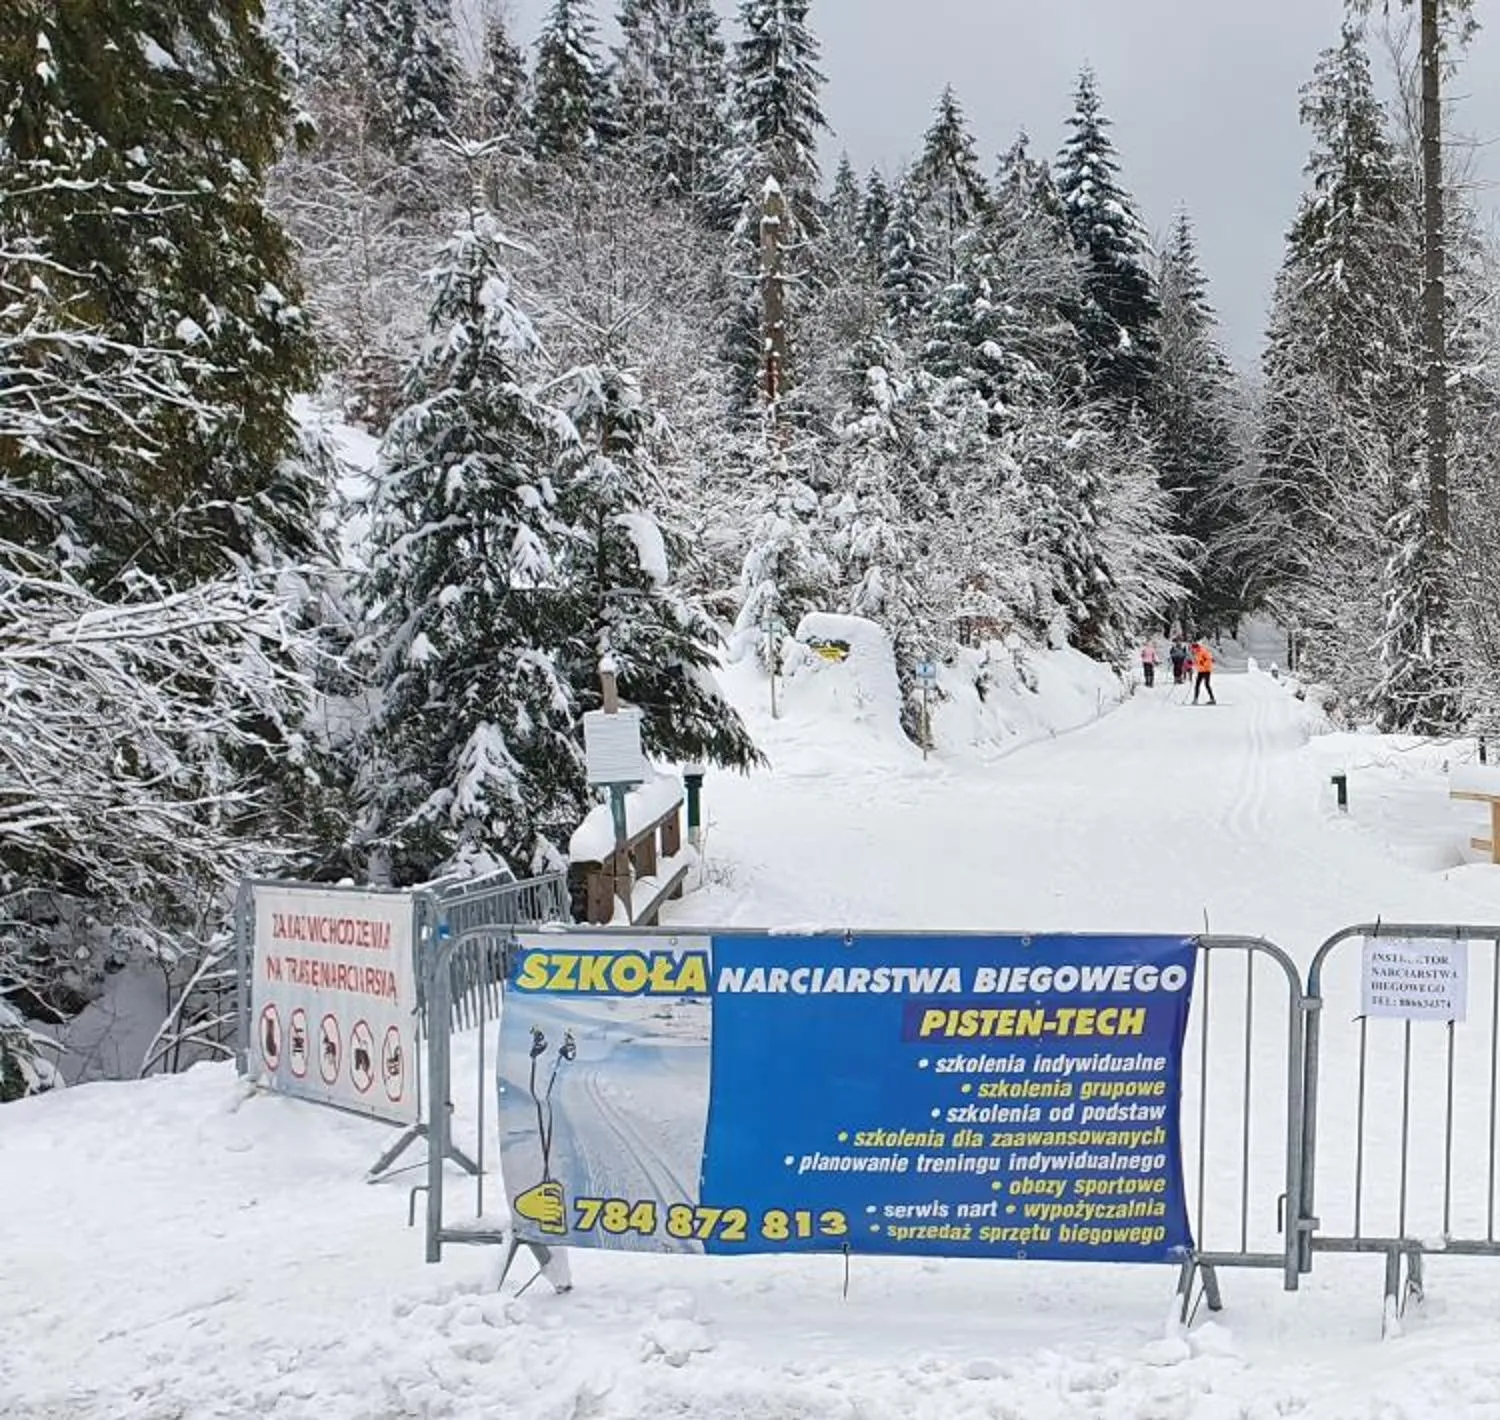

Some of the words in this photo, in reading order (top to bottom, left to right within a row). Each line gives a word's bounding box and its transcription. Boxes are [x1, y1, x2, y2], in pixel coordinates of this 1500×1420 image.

[1371, 953, 1449, 965] INSTTOR
[515, 953, 708, 992] SZKOŁA
[717, 965, 962, 994] NARCIARSTWA
[973, 964, 1188, 993] BIEGOWEGO
[1371, 967, 1458, 979] NARCIARSTWA
[1371, 981, 1445, 993] BIEGOWEGO
[919, 1007, 1147, 1037] PISTEN-TECH
[934, 1053, 1025, 1074] szkolenia
[1033, 1053, 1167, 1077] indywidualne
[977, 1079, 1073, 1098] szkolenia
[1079, 1080, 1166, 1101] grupowe
[946, 1103, 1041, 1123] szkolenia
[1049, 1103, 1072, 1122] od
[1081, 1103, 1166, 1124] podstaw
[853, 1127, 945, 1148] szkolenia
[952, 1128, 984, 1148] dla
[991, 1127, 1166, 1148] zaawansowanych
[798, 1152, 908, 1174] planowanie
[916, 1153, 1000, 1173] treningu
[1008, 1151, 1166, 1172] indywidualnego
[1009, 1176, 1066, 1198] obozy
[1074, 1177, 1166, 1197] sportowe
[574, 1198, 657, 1235] 784
[667, 1202, 748, 1240] 872
[762, 1208, 849, 1241] 813
[883, 1203, 949, 1219] serwis
[956, 1202, 998, 1219] nart
[1023, 1200, 1166, 1221] wypożyczalnia
[887, 1223, 971, 1242] sprzedaż
[978, 1224, 1051, 1243] sprzętu
[1059, 1223, 1166, 1244] biegowego
